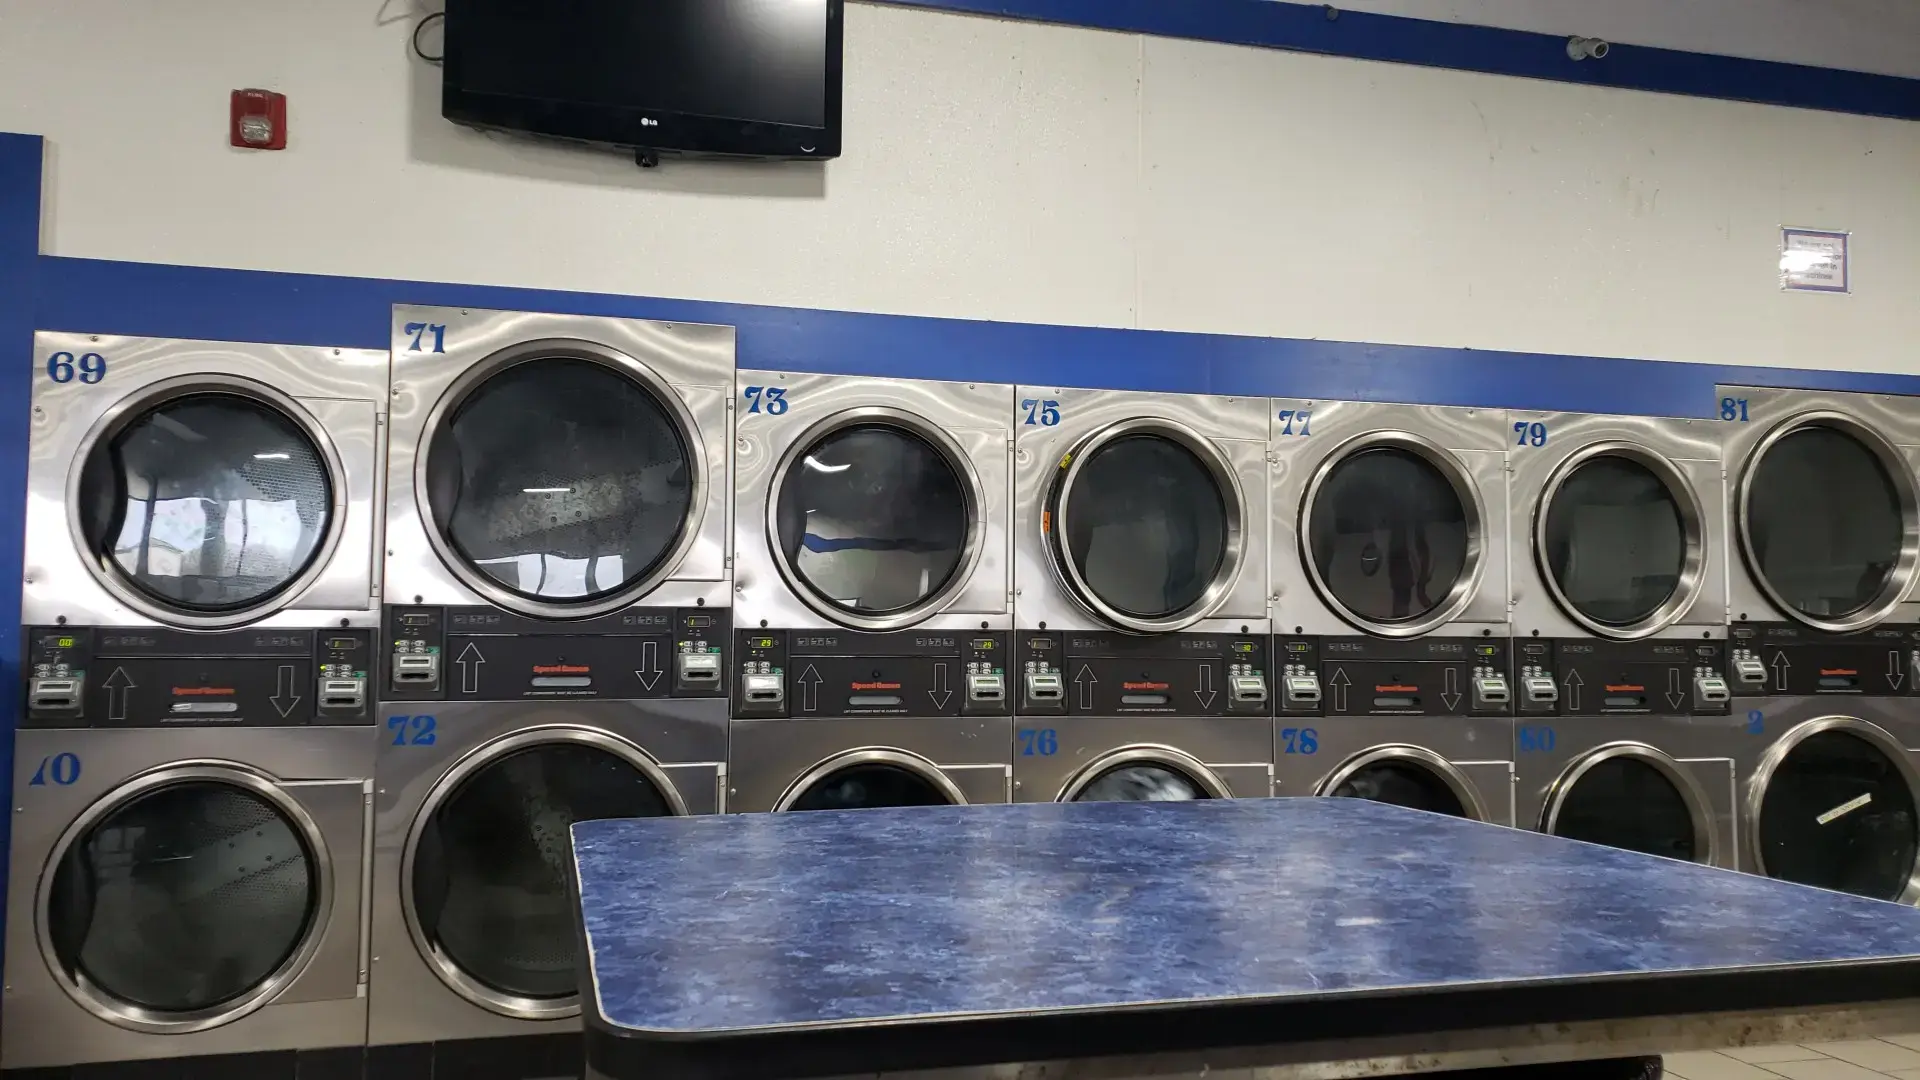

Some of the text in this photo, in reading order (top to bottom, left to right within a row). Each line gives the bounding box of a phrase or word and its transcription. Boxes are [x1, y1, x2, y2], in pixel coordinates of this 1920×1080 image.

[405, 322, 445, 354] 71
[48, 352, 107, 383] 69
[744, 385, 788, 415] 73
[1022, 400, 1060, 426] 75
[1720, 397, 1749, 422] 81
[1279, 410, 1310, 436] 77
[1513, 421, 1548, 447] 79
[387, 713, 438, 747] 72
[1018, 728, 1058, 757] 76
[1281, 727, 1319, 755] 78
